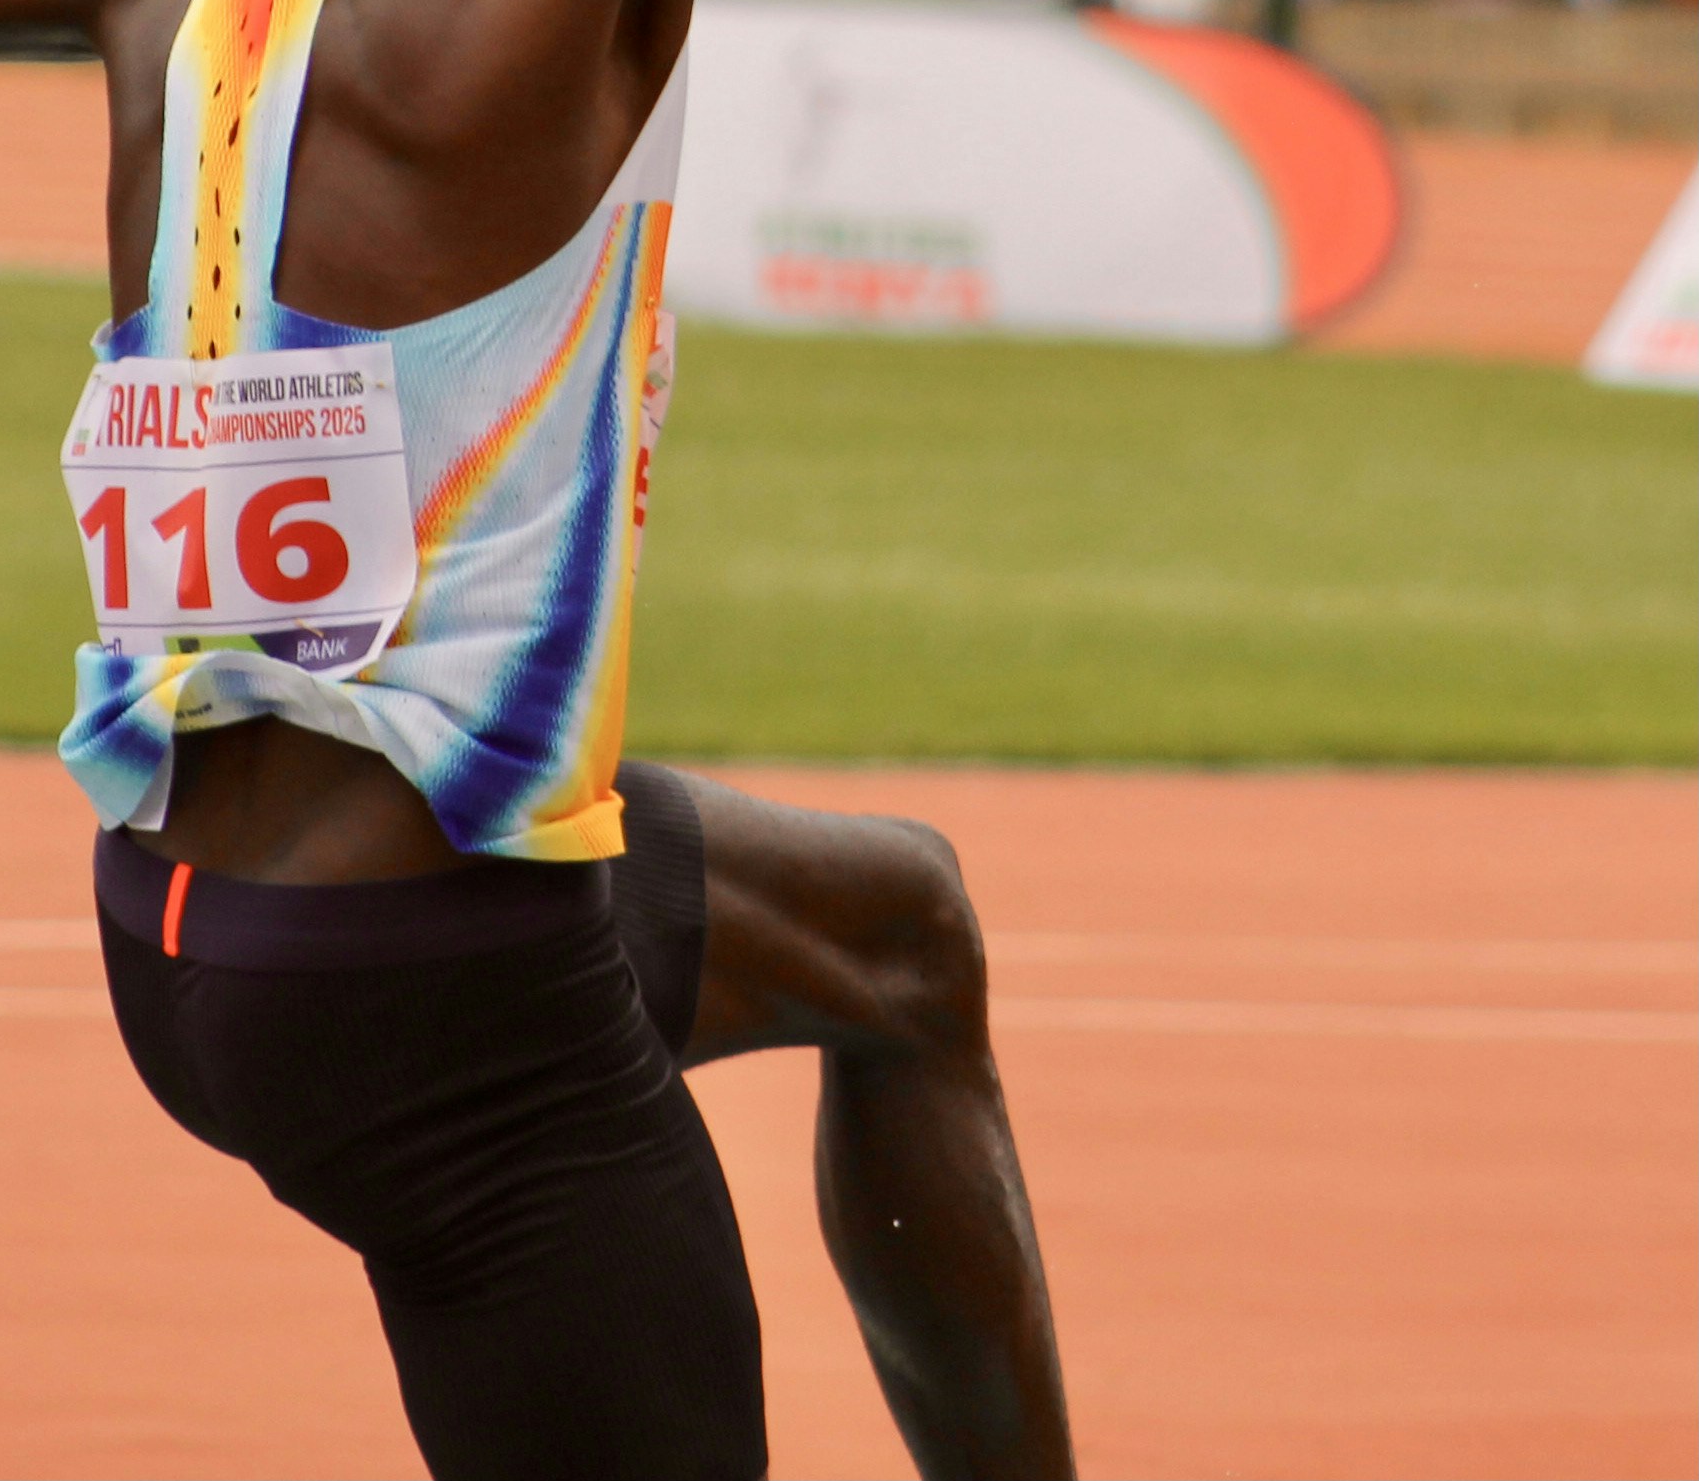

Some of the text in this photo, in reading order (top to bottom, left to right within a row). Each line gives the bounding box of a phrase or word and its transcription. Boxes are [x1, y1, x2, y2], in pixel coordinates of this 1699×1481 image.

[238, 377, 285, 404] WORLD
[289, 371, 364, 401] ATHLETICS
[96, 384, 214, 450] RIALS
[320, 405, 366, 437] 2025
[80, 476, 349, 610] 116
[296, 637, 349, 663] BANK
